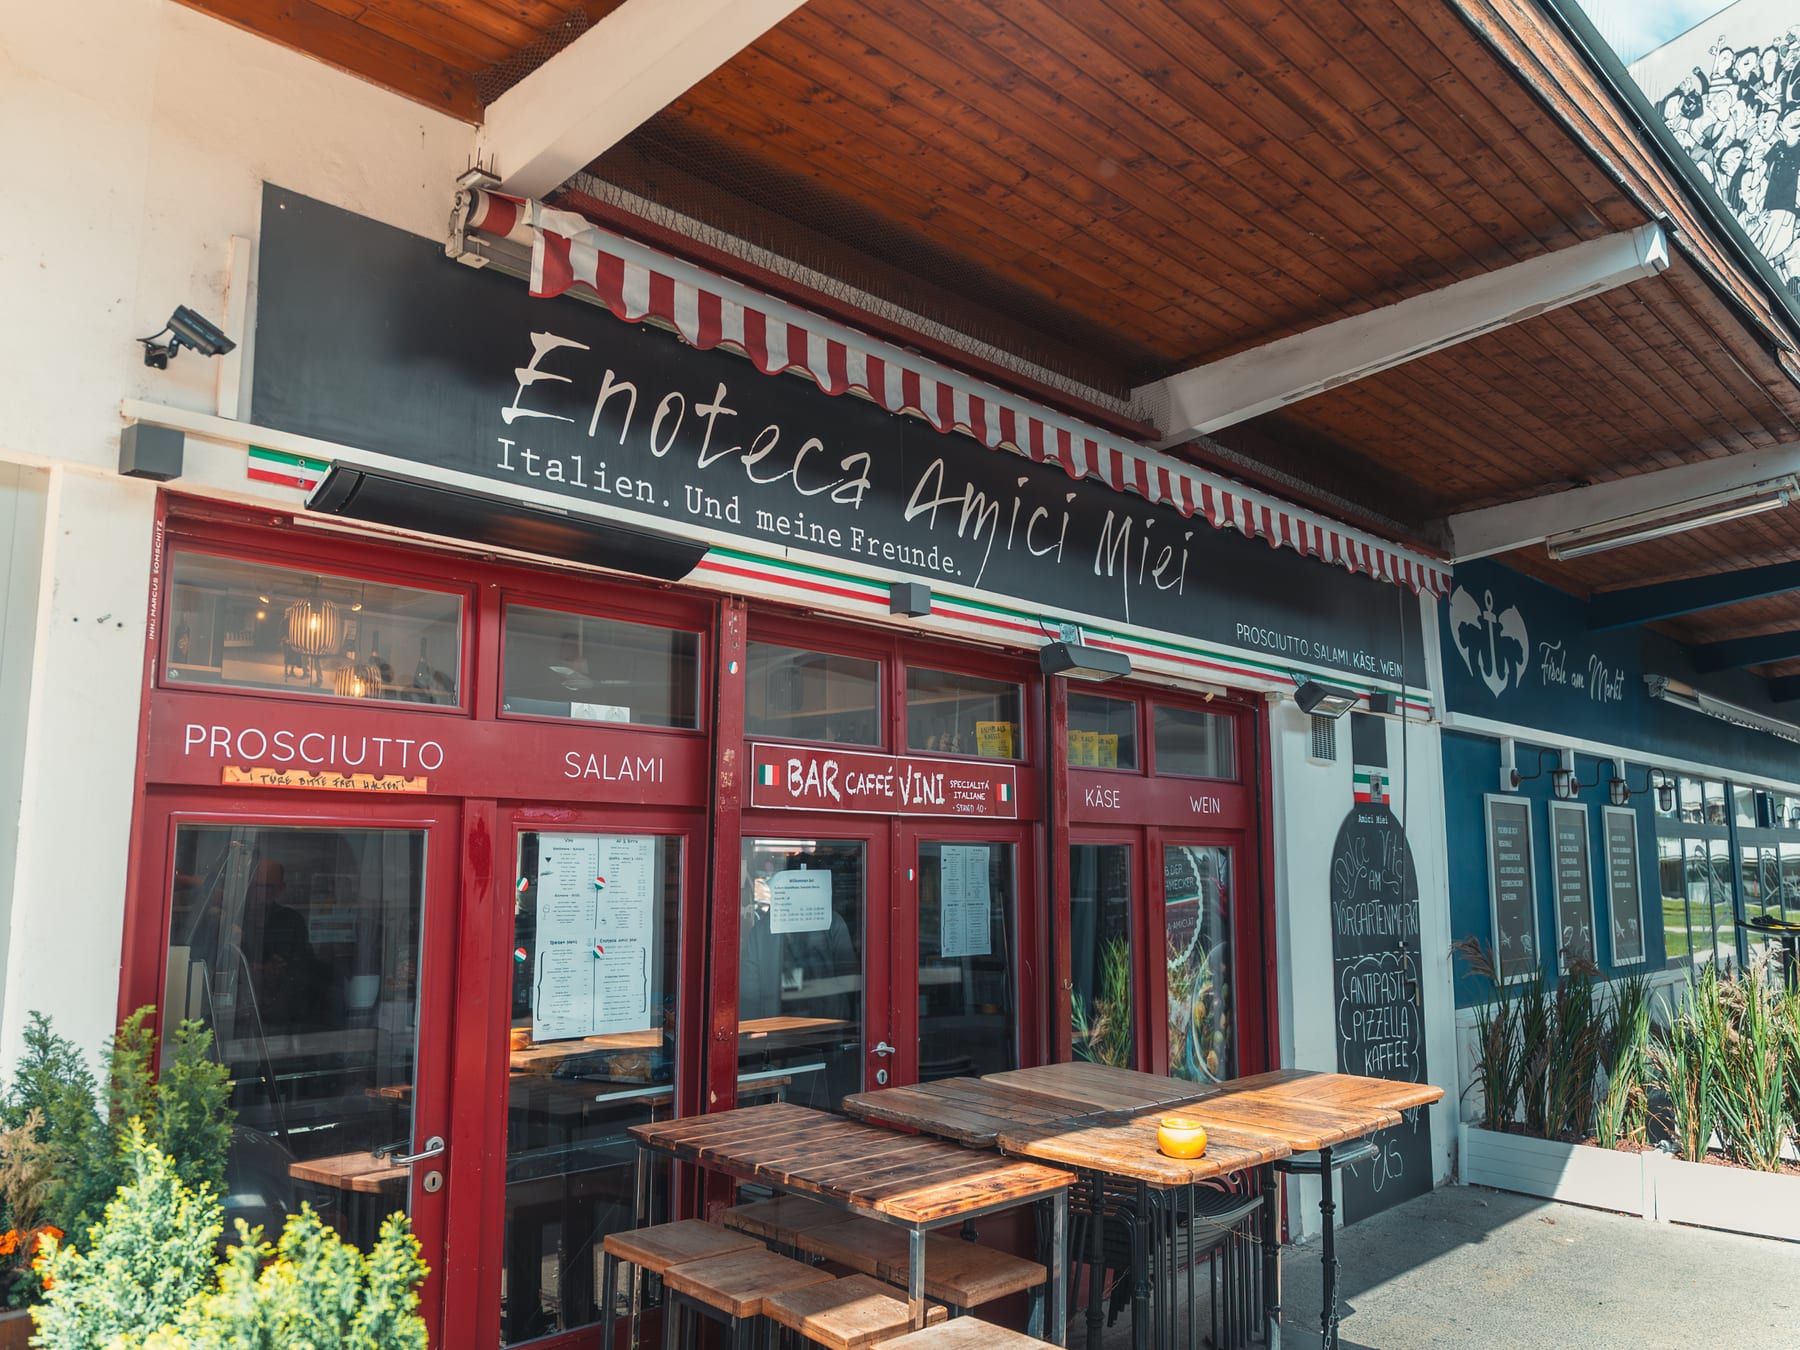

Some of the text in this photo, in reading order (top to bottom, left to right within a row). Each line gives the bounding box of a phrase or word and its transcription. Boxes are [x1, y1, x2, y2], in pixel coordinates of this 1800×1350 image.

[501, 331, 1194, 624] Enoteca Amici Miei
[497, 438, 963, 577] Italien. Und meine Freunde.
[150, 577, 159, 617] MARCUS
[1236, 623, 1403, 679] PROSCIUTTO. SALAMI. KÄSE. WEIN
[1539, 640, 1567, 686] Fisch
[185, 724, 444, 771] PROSCIUTTO
[564, 751, 664, 784] SALAMI
[787, 758, 946, 806] BAR CAFFÉ VINI
[1085, 785, 1121, 809] KÄSE
[1189, 795, 1221, 814] WEIN
[1352, 1006, 1409, 1043] PIZZELLA
[1364, 1041, 1409, 1077] KAFFEE
